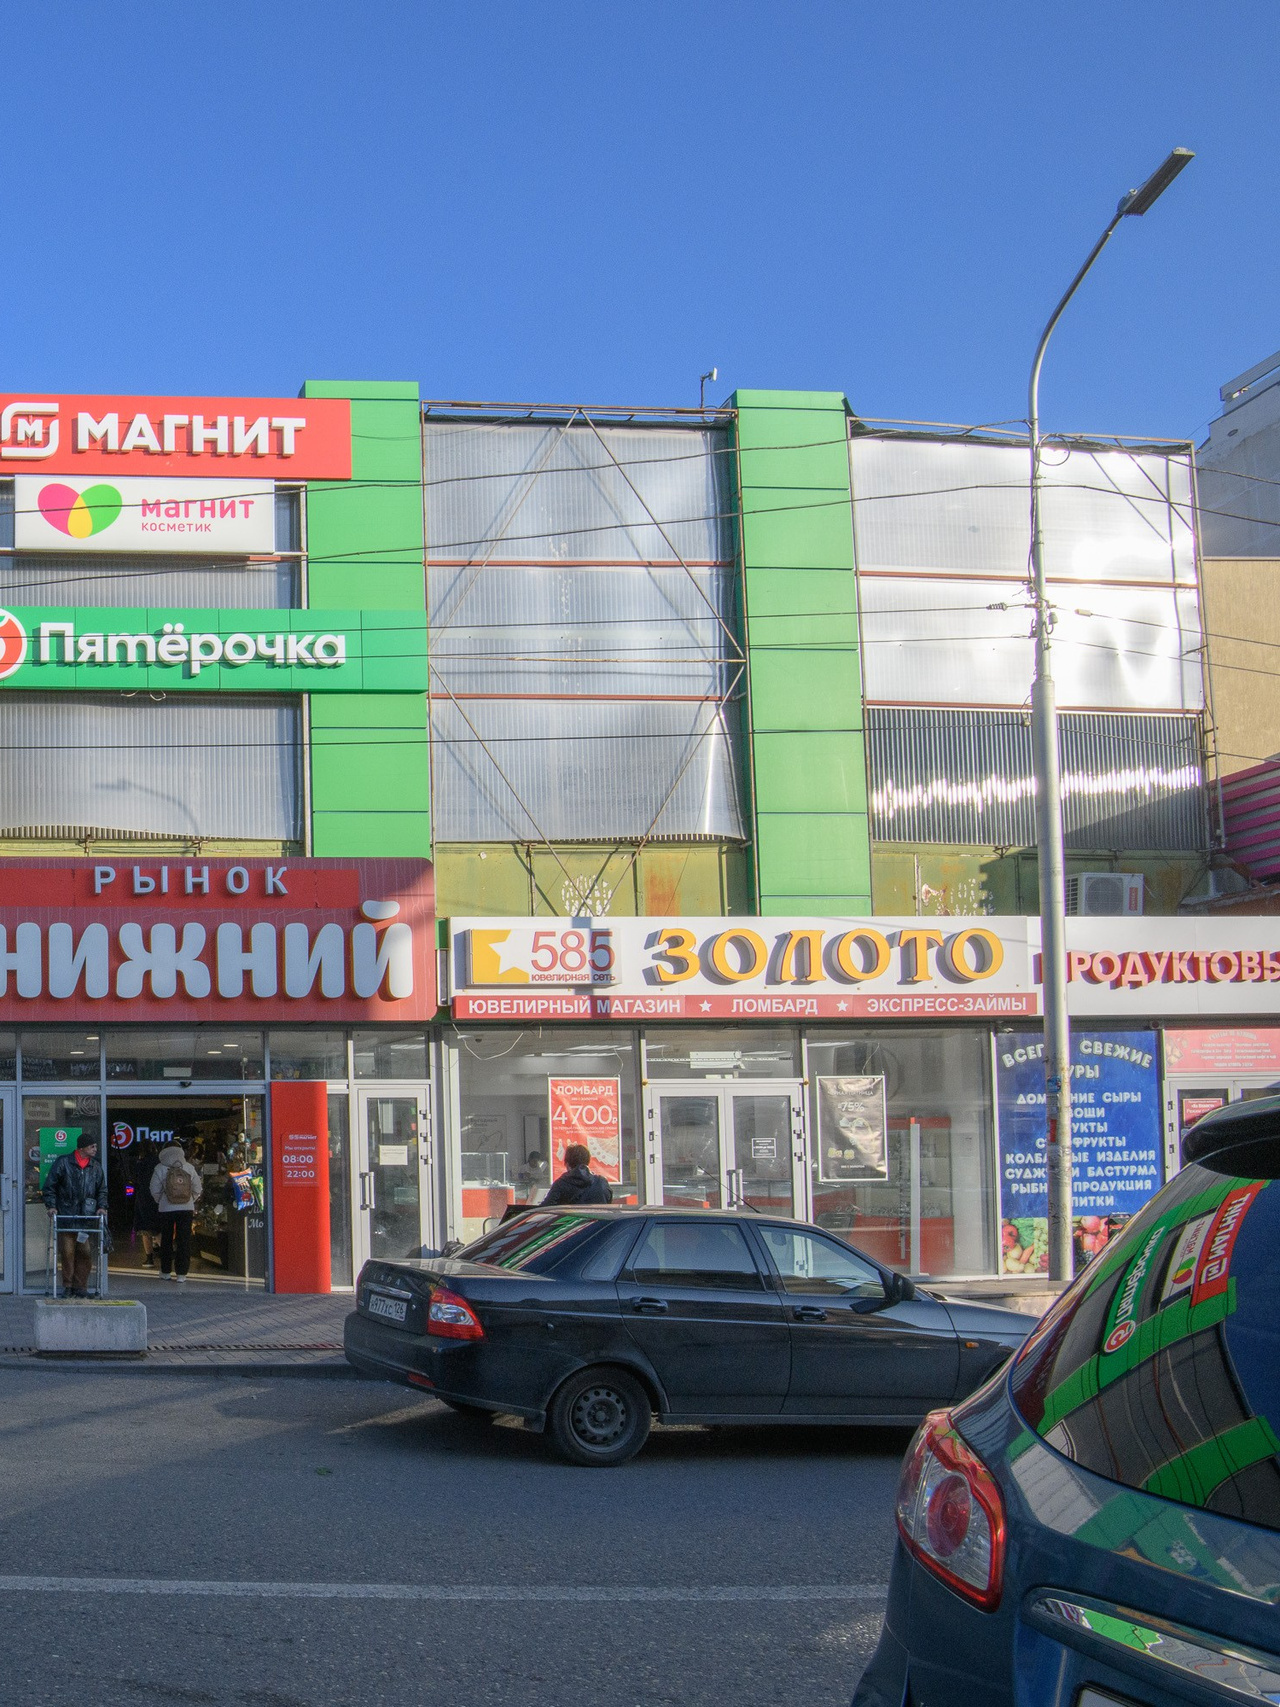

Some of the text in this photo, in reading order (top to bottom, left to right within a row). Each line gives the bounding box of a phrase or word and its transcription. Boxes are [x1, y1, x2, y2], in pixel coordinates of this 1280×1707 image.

[76, 412, 307, 457] МАГНИТ
[141, 497, 255, 519] магнит
[141, 521, 212, 533] косметик
[39, 622, 347, 677] Пятёрочка
[93, 865, 289, 897] РЫНОК
[530, 930, 616, 972] 585
[652, 928, 1005, 984] ЗОЛОТО
[531, 972, 616, 983] ювелирная сеть
[468, 993, 1027, 1014] ЮВЕЛИРНЫЙ МАГАЗИН ЛОМБАРД ЭКСПРЕСС-ЗАЙМЫ
[1002, 1039, 1153, 1069] ВСЕГ СВЕЖИЕ
[556, 1085, 614, 1096] ЛОМБАРД
[1016, 1091, 1142, 1105] ДОМНИЕ СЫРЫ
[1071, 1122, 1108, 1134] УКТЫ
[282, 1155, 314, 1164] 08:00
[1096, 1149, 1156, 1162] ИЗДЕЛИЯ
[287, 1170, 315, 1178] 22:00
[1005, 1167, 1048, 1180] СУДЖ
[1086, 1164, 1158, 1178] БАСТУРМА
[1011, 1179, 1152, 1195] РЫБН ПРОДУКЦИЯ
[1071, 1195, 1115, 1208] ПИТКИ
